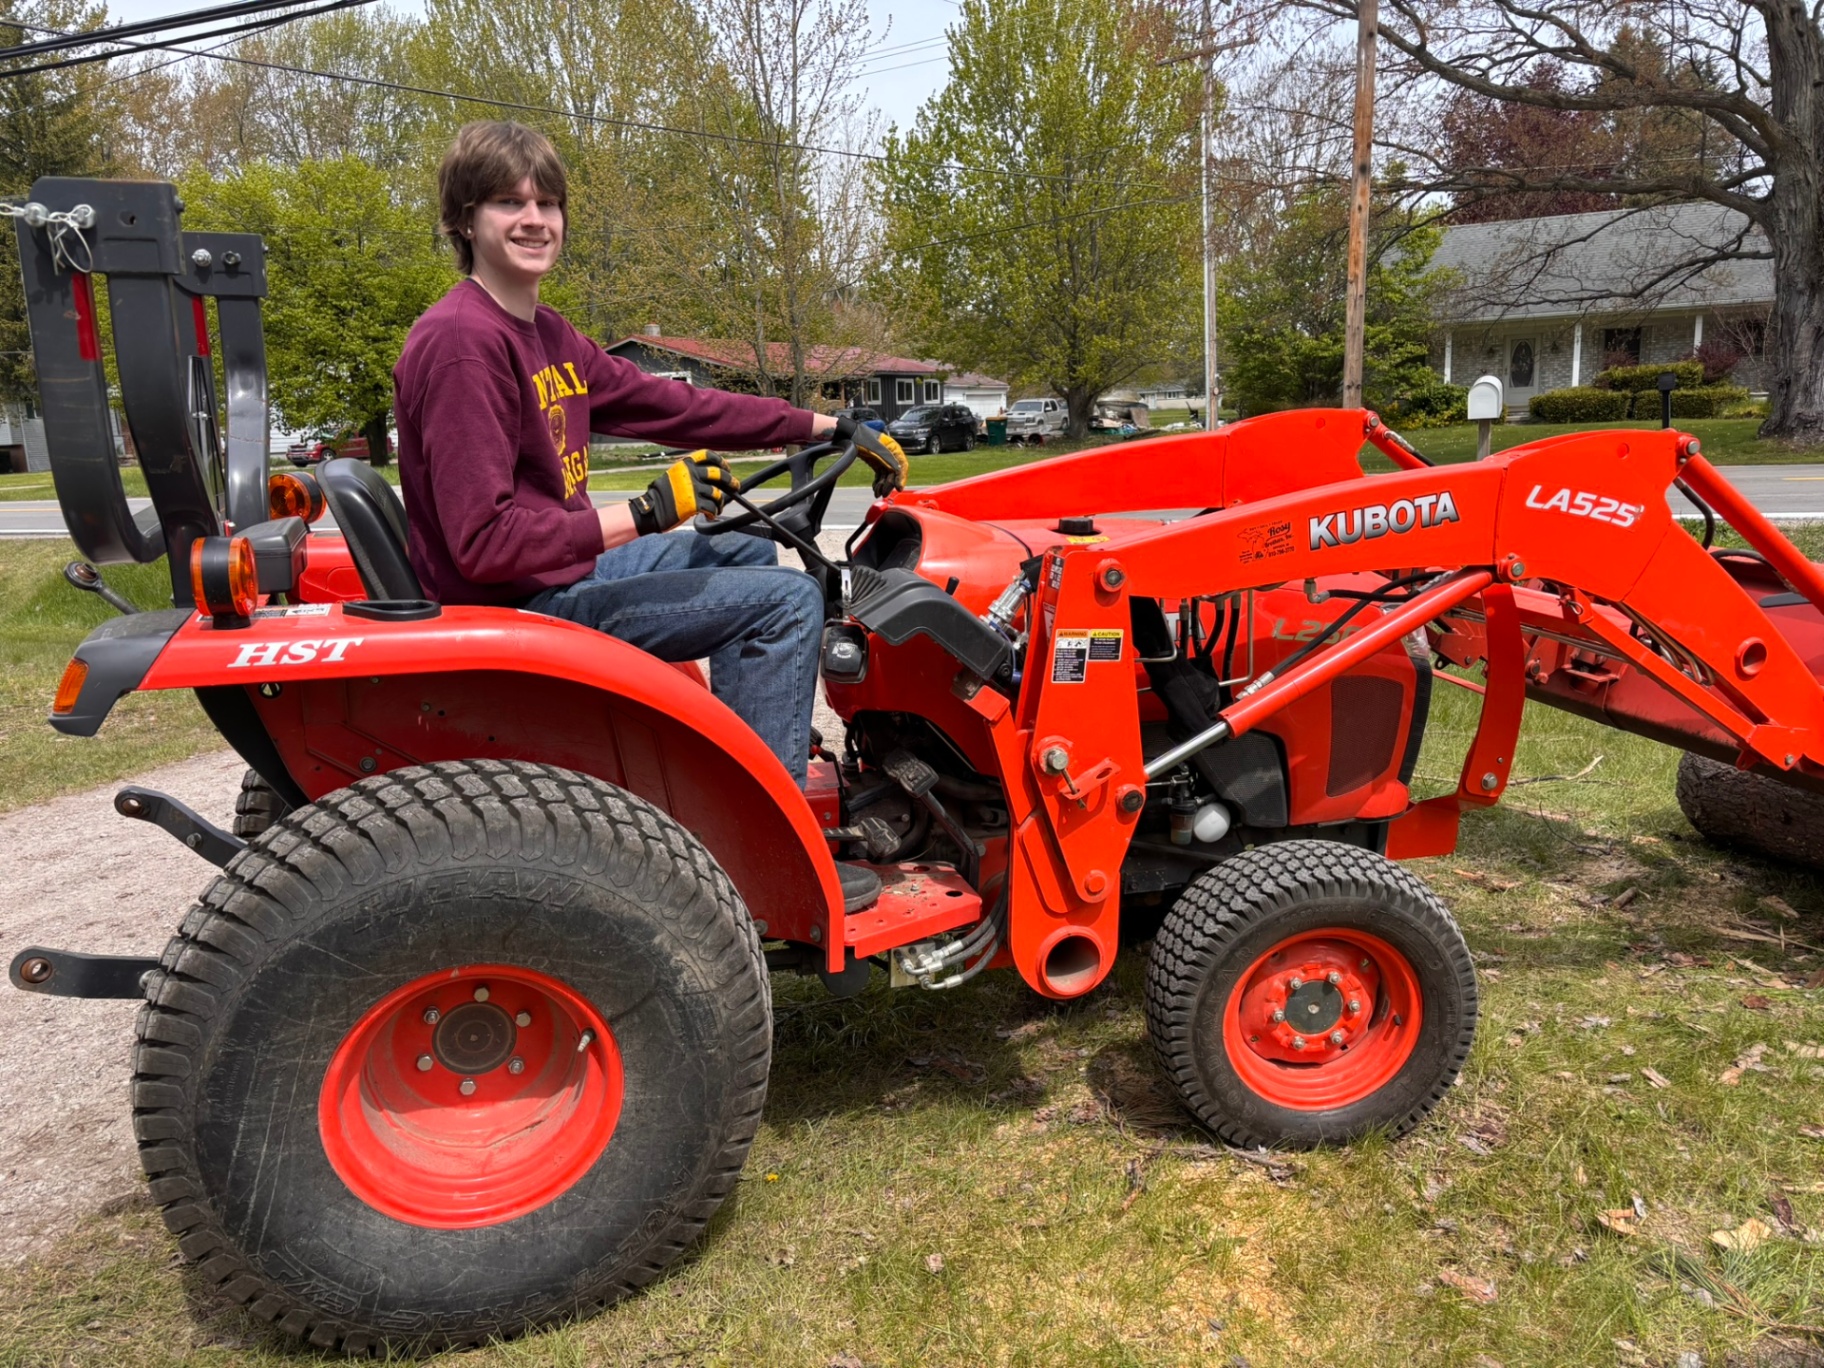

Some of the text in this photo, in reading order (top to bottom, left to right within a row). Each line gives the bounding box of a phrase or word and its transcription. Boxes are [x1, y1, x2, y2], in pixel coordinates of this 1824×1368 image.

[1309, 490, 1460, 551] KUBOTA
[1525, 484, 1645, 528] LA525
[226, 636, 365, 668] HST
